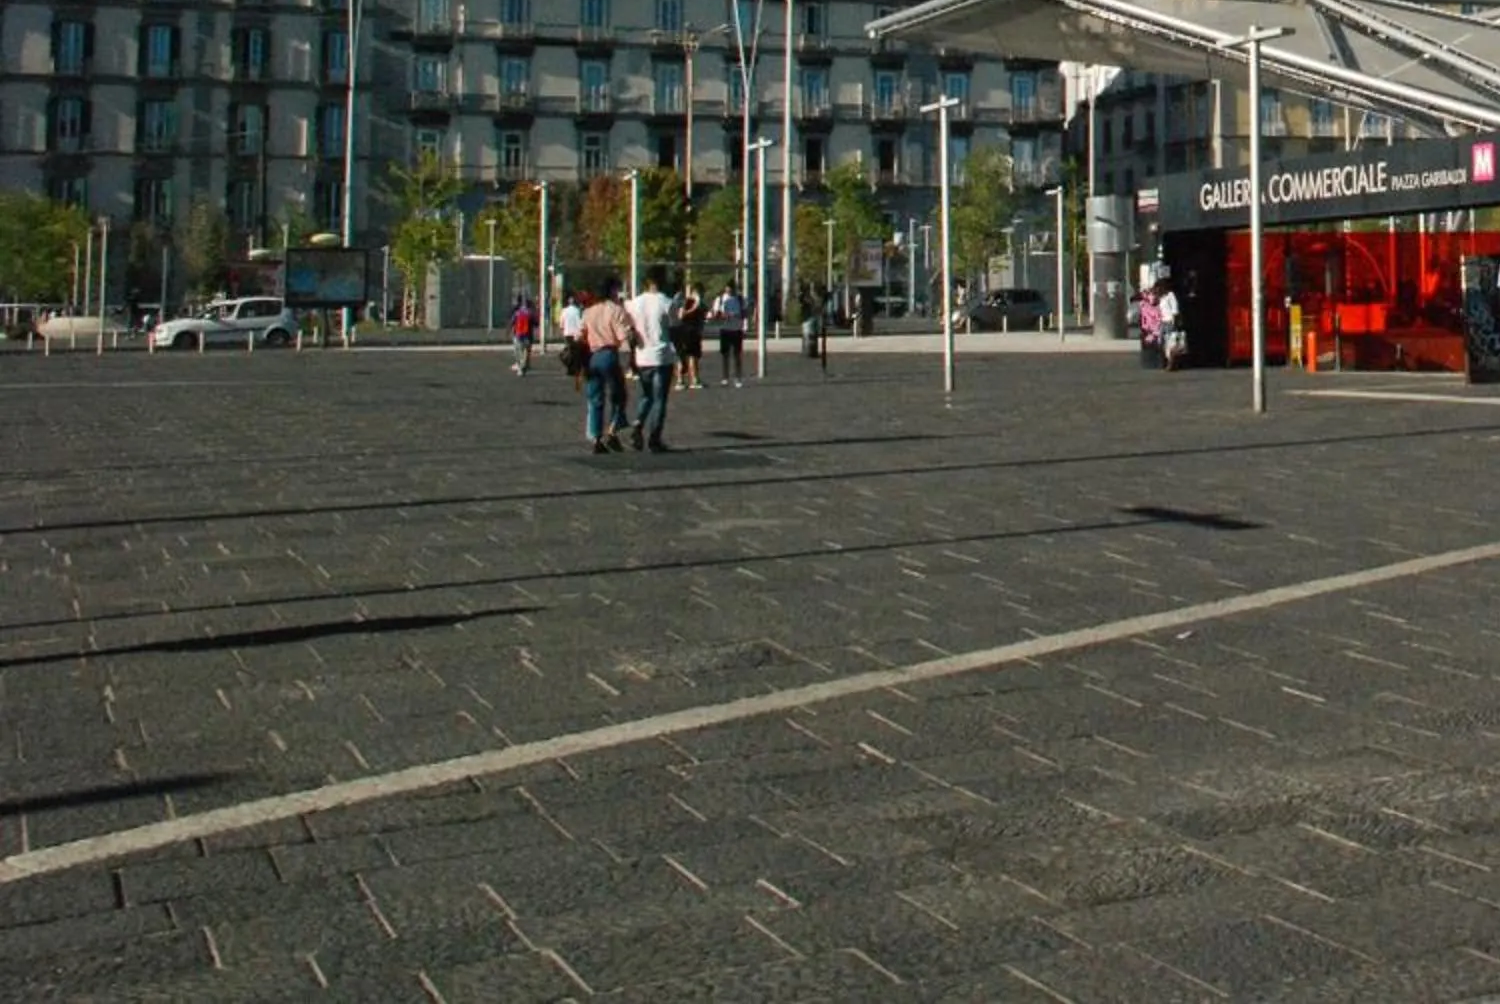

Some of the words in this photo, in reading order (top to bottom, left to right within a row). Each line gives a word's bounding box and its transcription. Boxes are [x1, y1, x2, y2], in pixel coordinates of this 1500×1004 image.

[1474, 145, 1494, 179] M
[1200, 178, 1266, 211] GALLER
[1269, 161, 1387, 204] COMMERCIALE
[1391, 173, 1419, 190] PIAZZA
[1421, 168, 1467, 188] GARIBALDI
